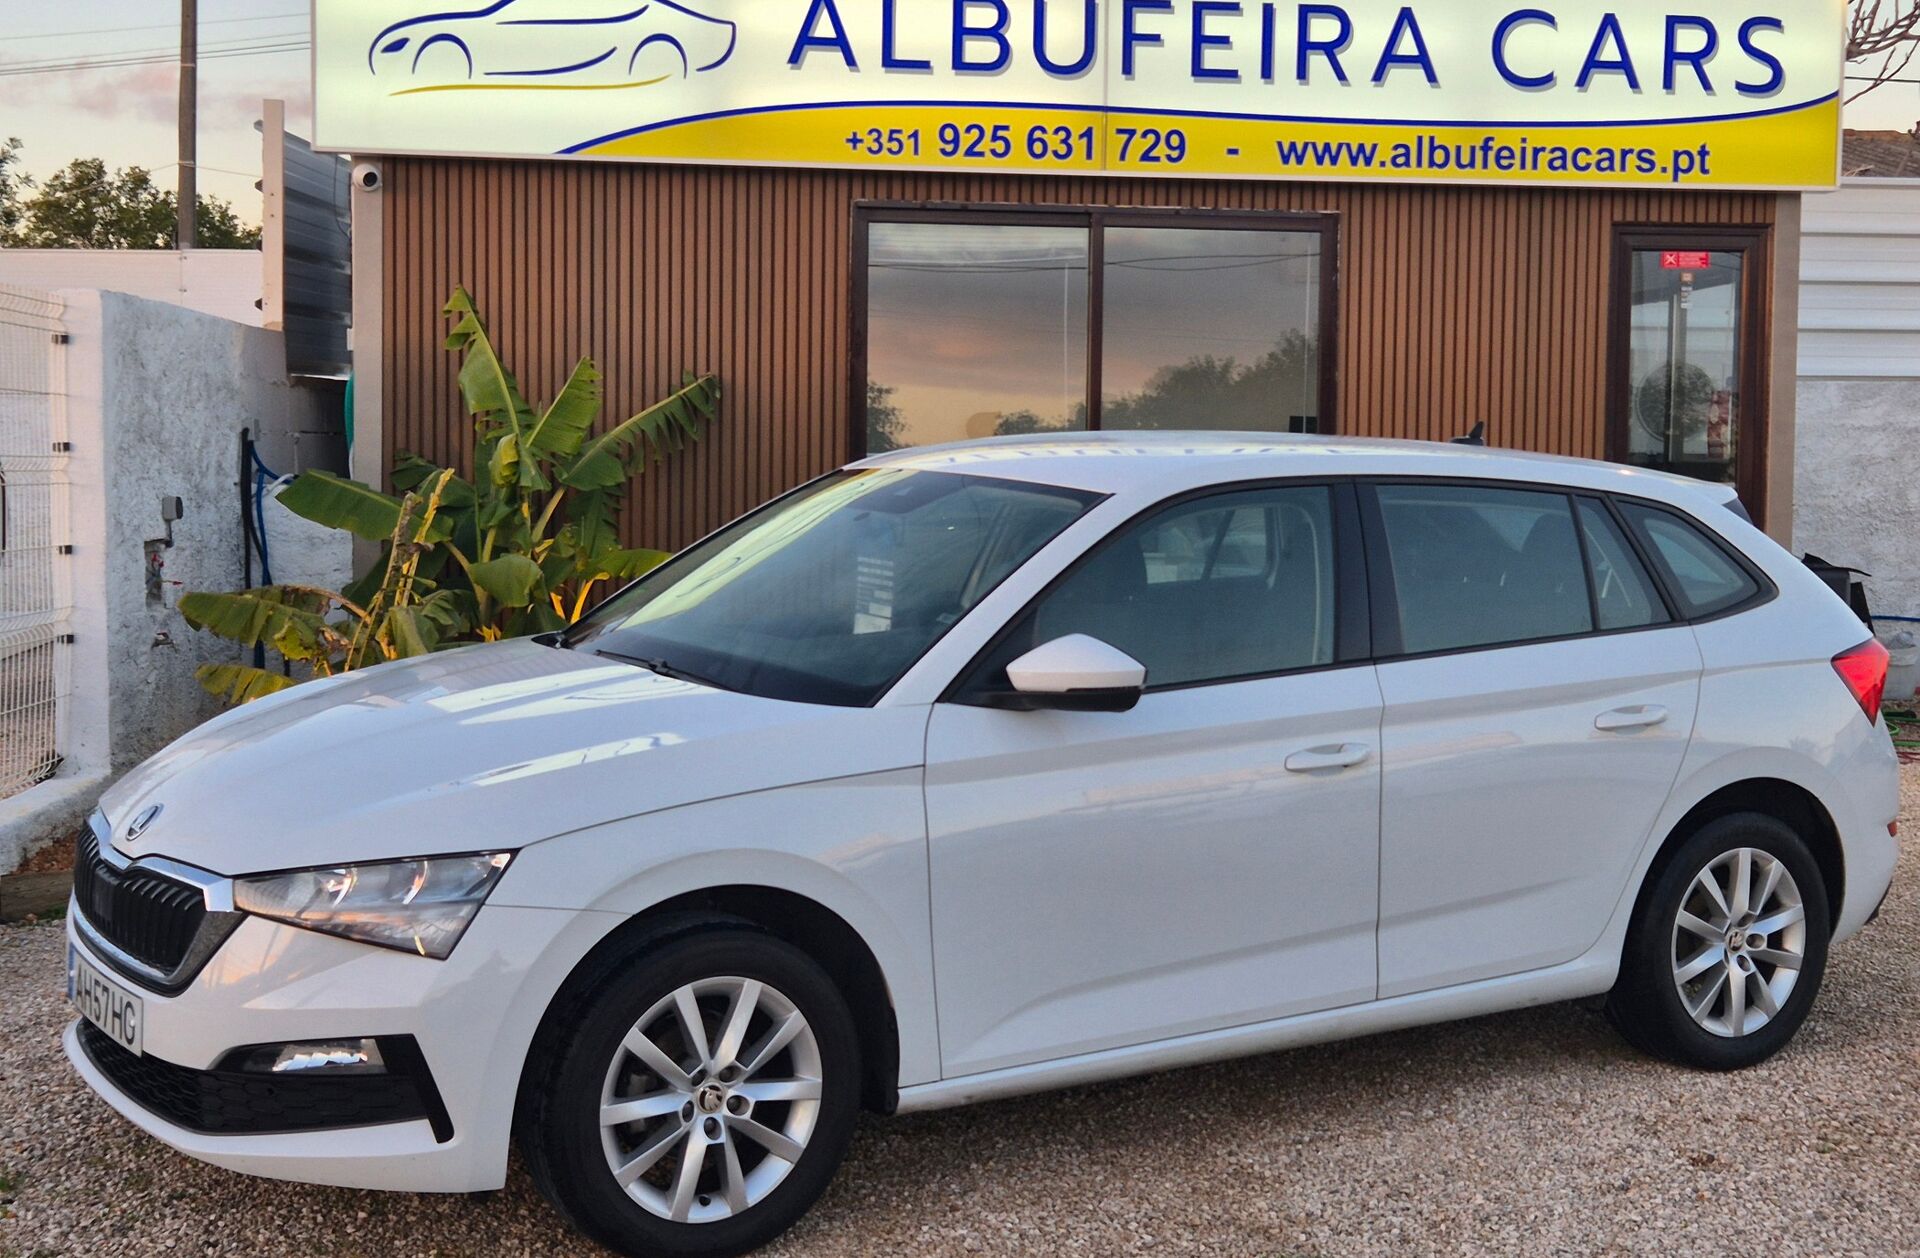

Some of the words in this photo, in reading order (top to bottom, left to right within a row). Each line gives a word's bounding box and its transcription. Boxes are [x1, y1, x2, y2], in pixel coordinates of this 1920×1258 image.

[788, 0, 1439, 86] ALBUFEIRA
[1491, 9, 1785, 95] CARS
[845, 129, 919, 156] +351
[939, 123, 1011, 158] 925
[1027, 126, 1093, 160] 631
[1117, 129, 1186, 163] 729
[1277, 136, 1709, 181] www.albufeiracars.pt
[77, 963, 136, 1045] AH57HG
